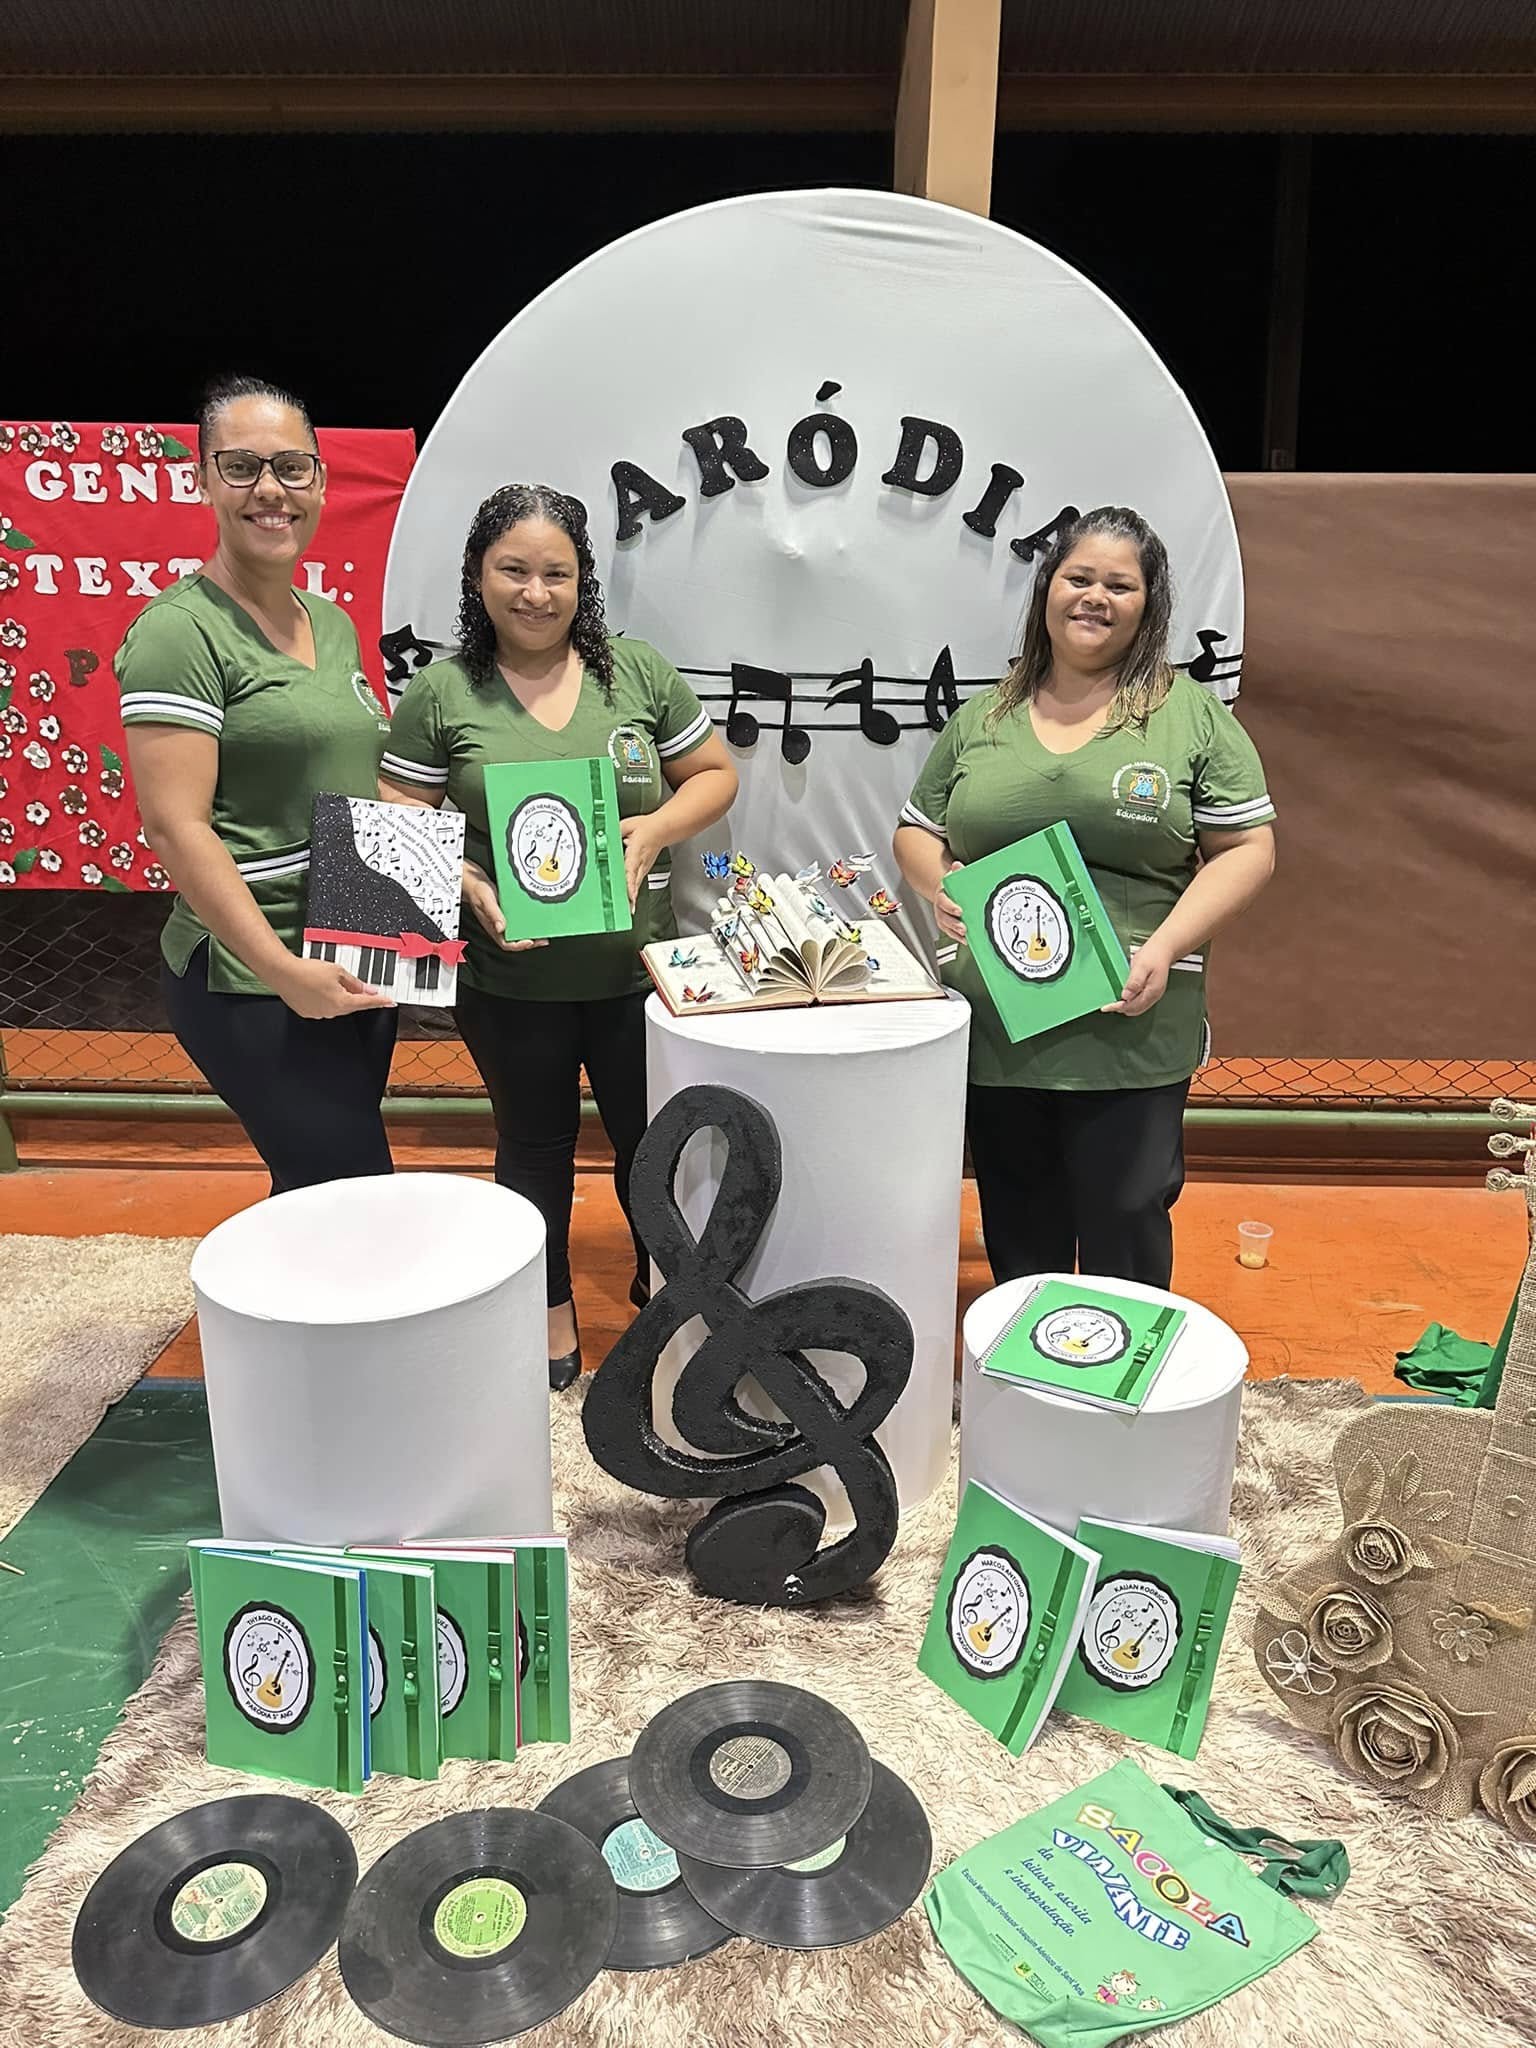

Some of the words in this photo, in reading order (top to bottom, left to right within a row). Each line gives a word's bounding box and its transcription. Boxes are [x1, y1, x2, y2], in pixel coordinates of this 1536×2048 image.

[25, 460, 201, 504] GENE
[590, 379, 1080, 562] ARÓDIA
[981, 1560, 1005, 1571] MARCOS
[1004, 1569, 1025, 1598] ANTONIO
[1114, 1583, 1139, 1593] KAUAN
[1140, 1585, 1169, 1605] RODRIGO
[246, 1614, 273, 1626] THYAGO
[273, 1616, 293, 1634] CESAR
[981, 1659, 993, 1667] ANO
[1132, 1672, 1148, 1680] ANO
[280, 1709, 294, 1720] ANO
[1037, 1847, 1054, 1861] da
[1075, 1802, 1250, 1948] SACOLA
[961, 1868, 977, 1886] Escola
[975, 1883, 999, 1907] Municipal
[995, 1904, 1019, 1927] Professor
[1016, 1927, 1038, 1948] Joaquim
[1010, 1874, 1075, 1937] interpretação.
[1055, 1891, 1092, 1924] escrita
